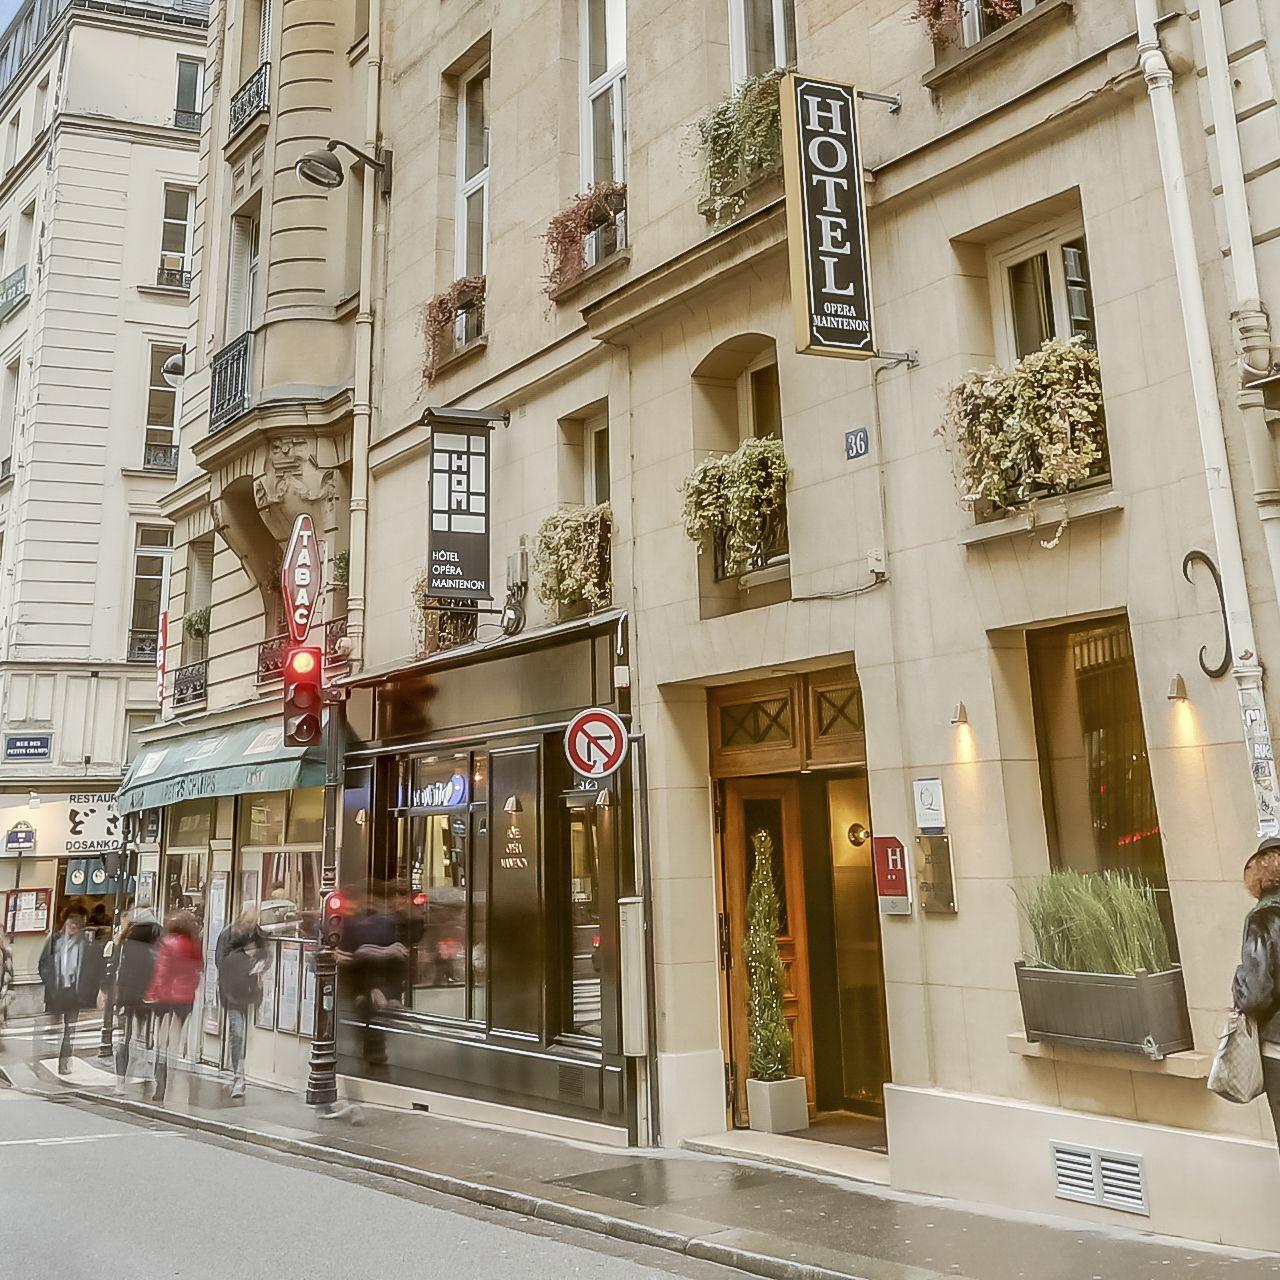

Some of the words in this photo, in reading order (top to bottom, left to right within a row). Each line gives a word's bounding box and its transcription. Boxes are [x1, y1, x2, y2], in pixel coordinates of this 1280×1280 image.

[803, 95, 854, 296] HOTEL
[823, 302, 856, 317] OPERA
[812, 315, 869, 331] MAINTENON
[848, 431, 866, 457] 36
[451, 453, 468, 510] HOM
[432, 549, 460, 562] HÔTEL
[294, 531, 312, 624] TABAC
[431, 564, 463, 576] OPÉRA
[431, 579, 485, 590] MAINTENON
[65, 840, 119, 850] DOSANKO
[887, 847, 904, 870] H
